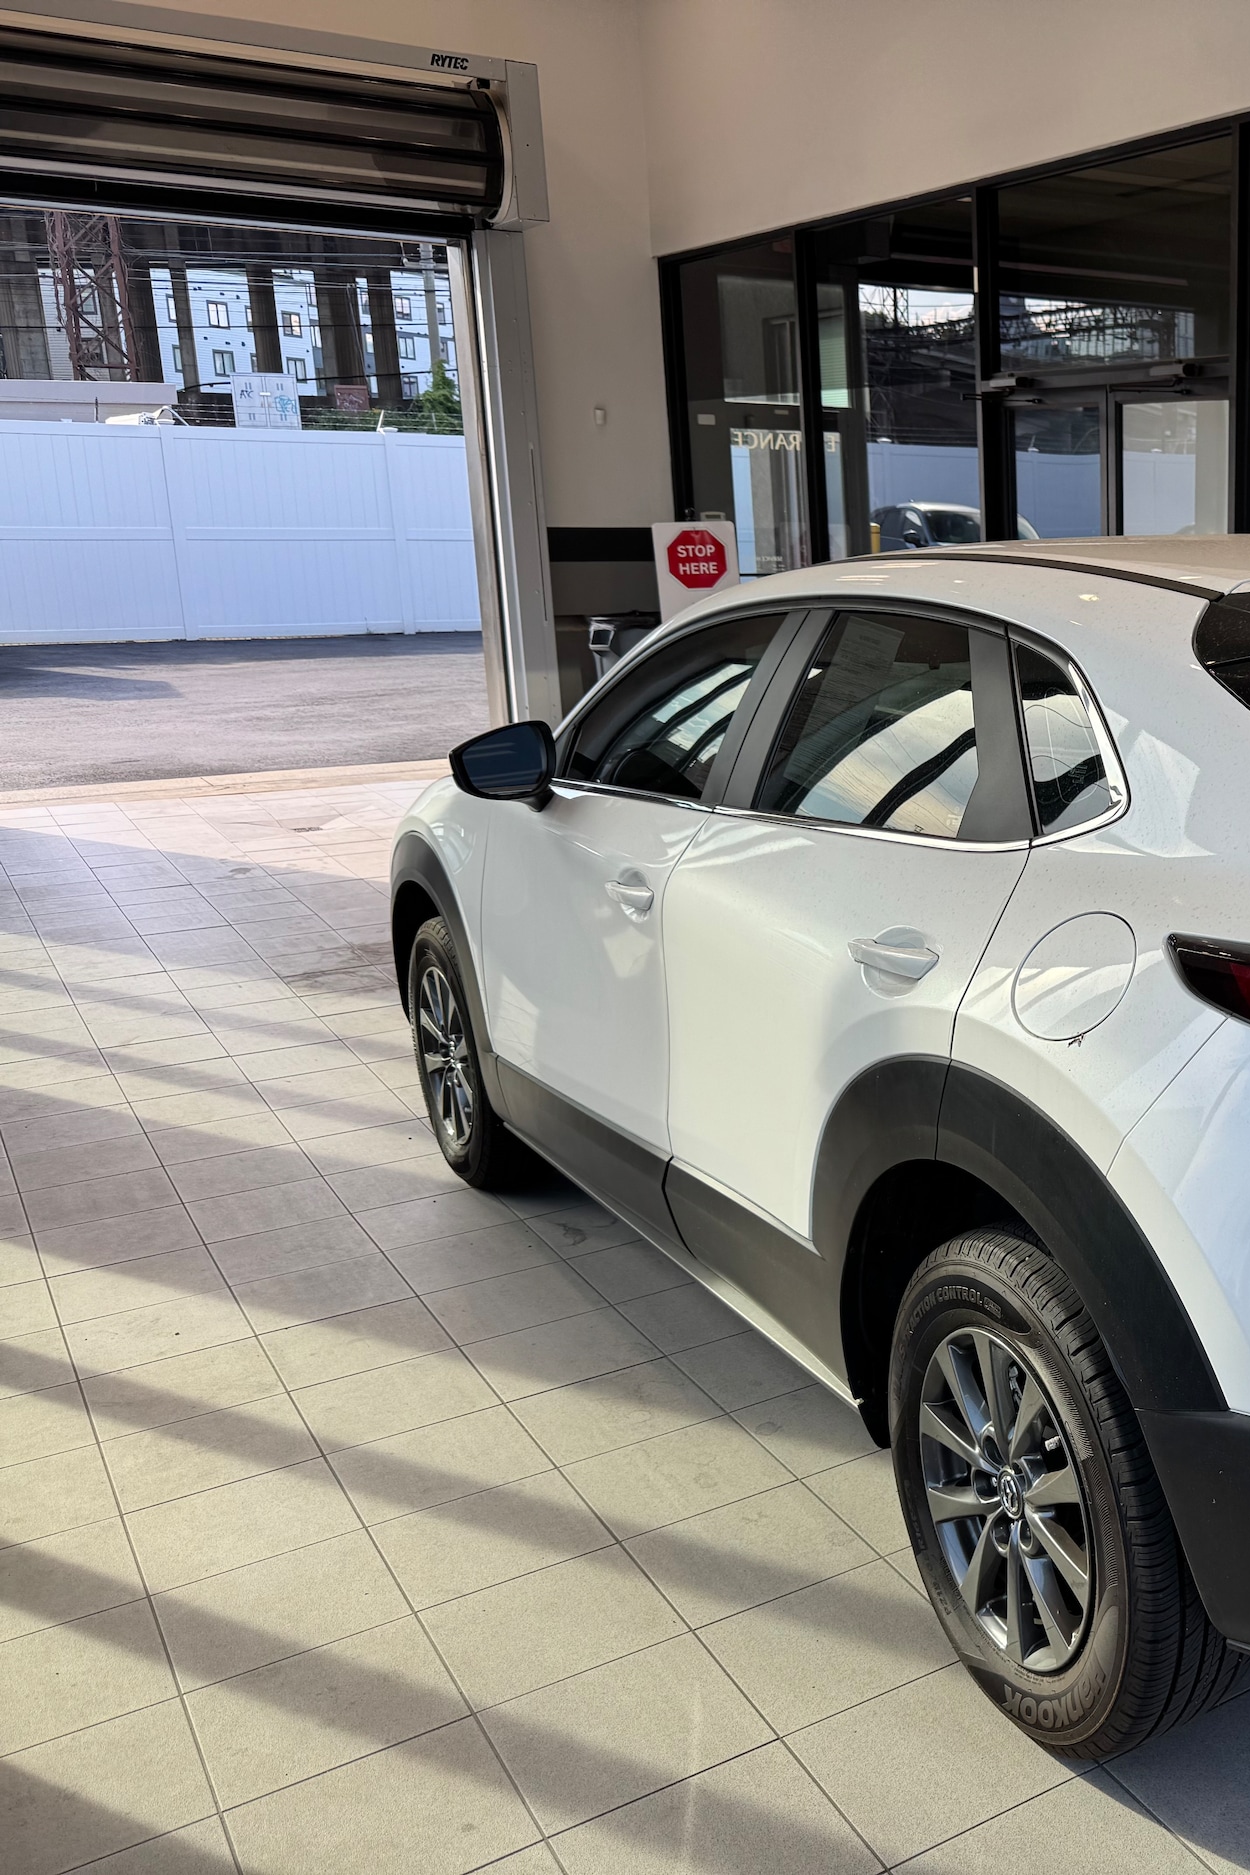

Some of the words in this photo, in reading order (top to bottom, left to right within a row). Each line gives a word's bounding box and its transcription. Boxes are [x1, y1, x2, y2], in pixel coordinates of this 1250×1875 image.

[430, 53, 470, 70] RYTEC
[676, 544, 716, 558] STOP
[678, 562, 719, 575] HERE
[936, 1285, 983, 1306] CONTROL
